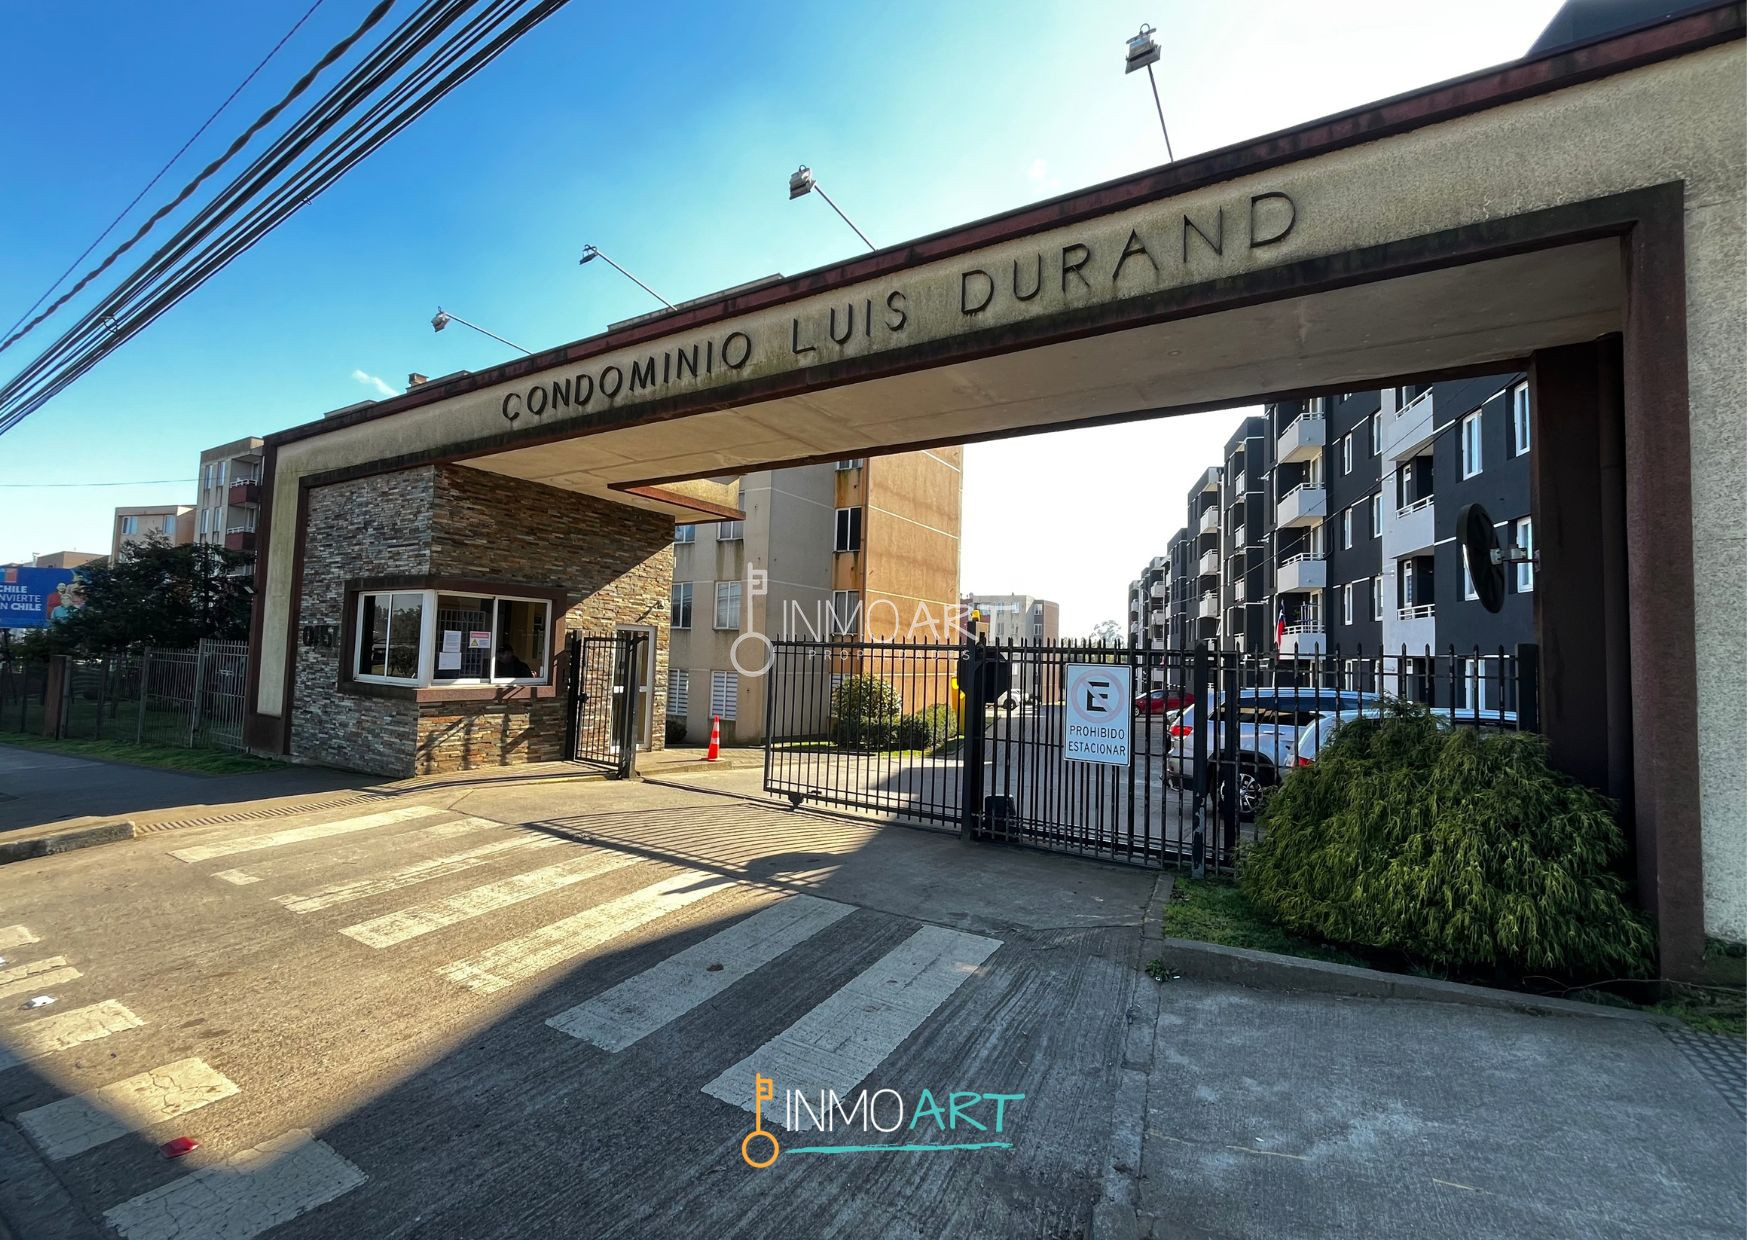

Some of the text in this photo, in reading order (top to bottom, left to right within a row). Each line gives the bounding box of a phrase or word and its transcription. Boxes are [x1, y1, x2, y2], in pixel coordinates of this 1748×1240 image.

[501, 190, 1297, 421] CONDOMINIO LUIS DURAND
[0, 594, 41, 603] NVIERTE
[0, 602, 42, 611] N CHILE
[1069, 725, 1125, 739] PROHIBIDO
[1068, 741, 1126, 756] ESTACIONAR
